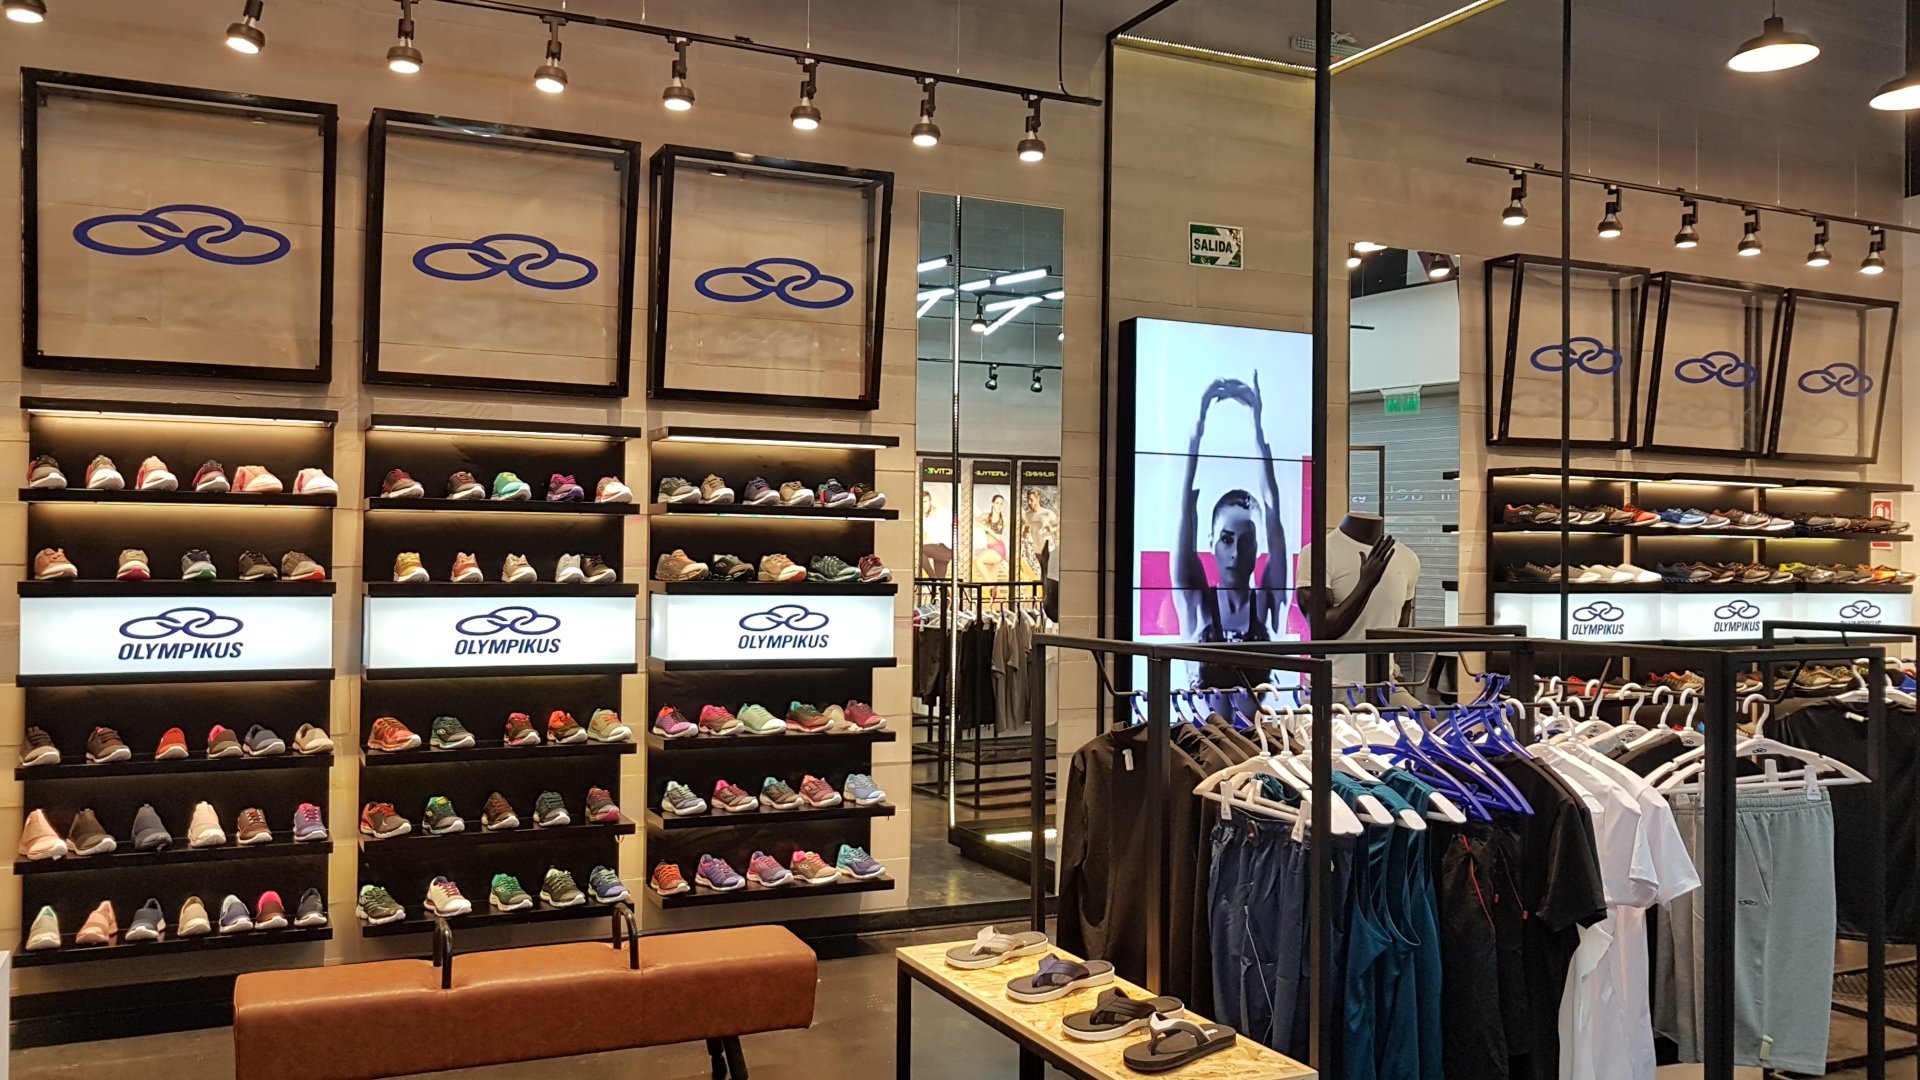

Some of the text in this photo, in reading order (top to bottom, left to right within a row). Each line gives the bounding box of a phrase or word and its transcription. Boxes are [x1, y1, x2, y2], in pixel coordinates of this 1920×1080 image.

[1193, 238, 1233, 253] SALIDA
[1572, 624, 1624, 635] OLYMPIKUS
[1713, 621, 1760, 632] OLYMPIKUS
[454, 638, 561, 655] OLYMPIKUS
[738, 634, 830, 649] OLYMPIKUS
[118, 642, 244, 660] OLYMPIKUS
